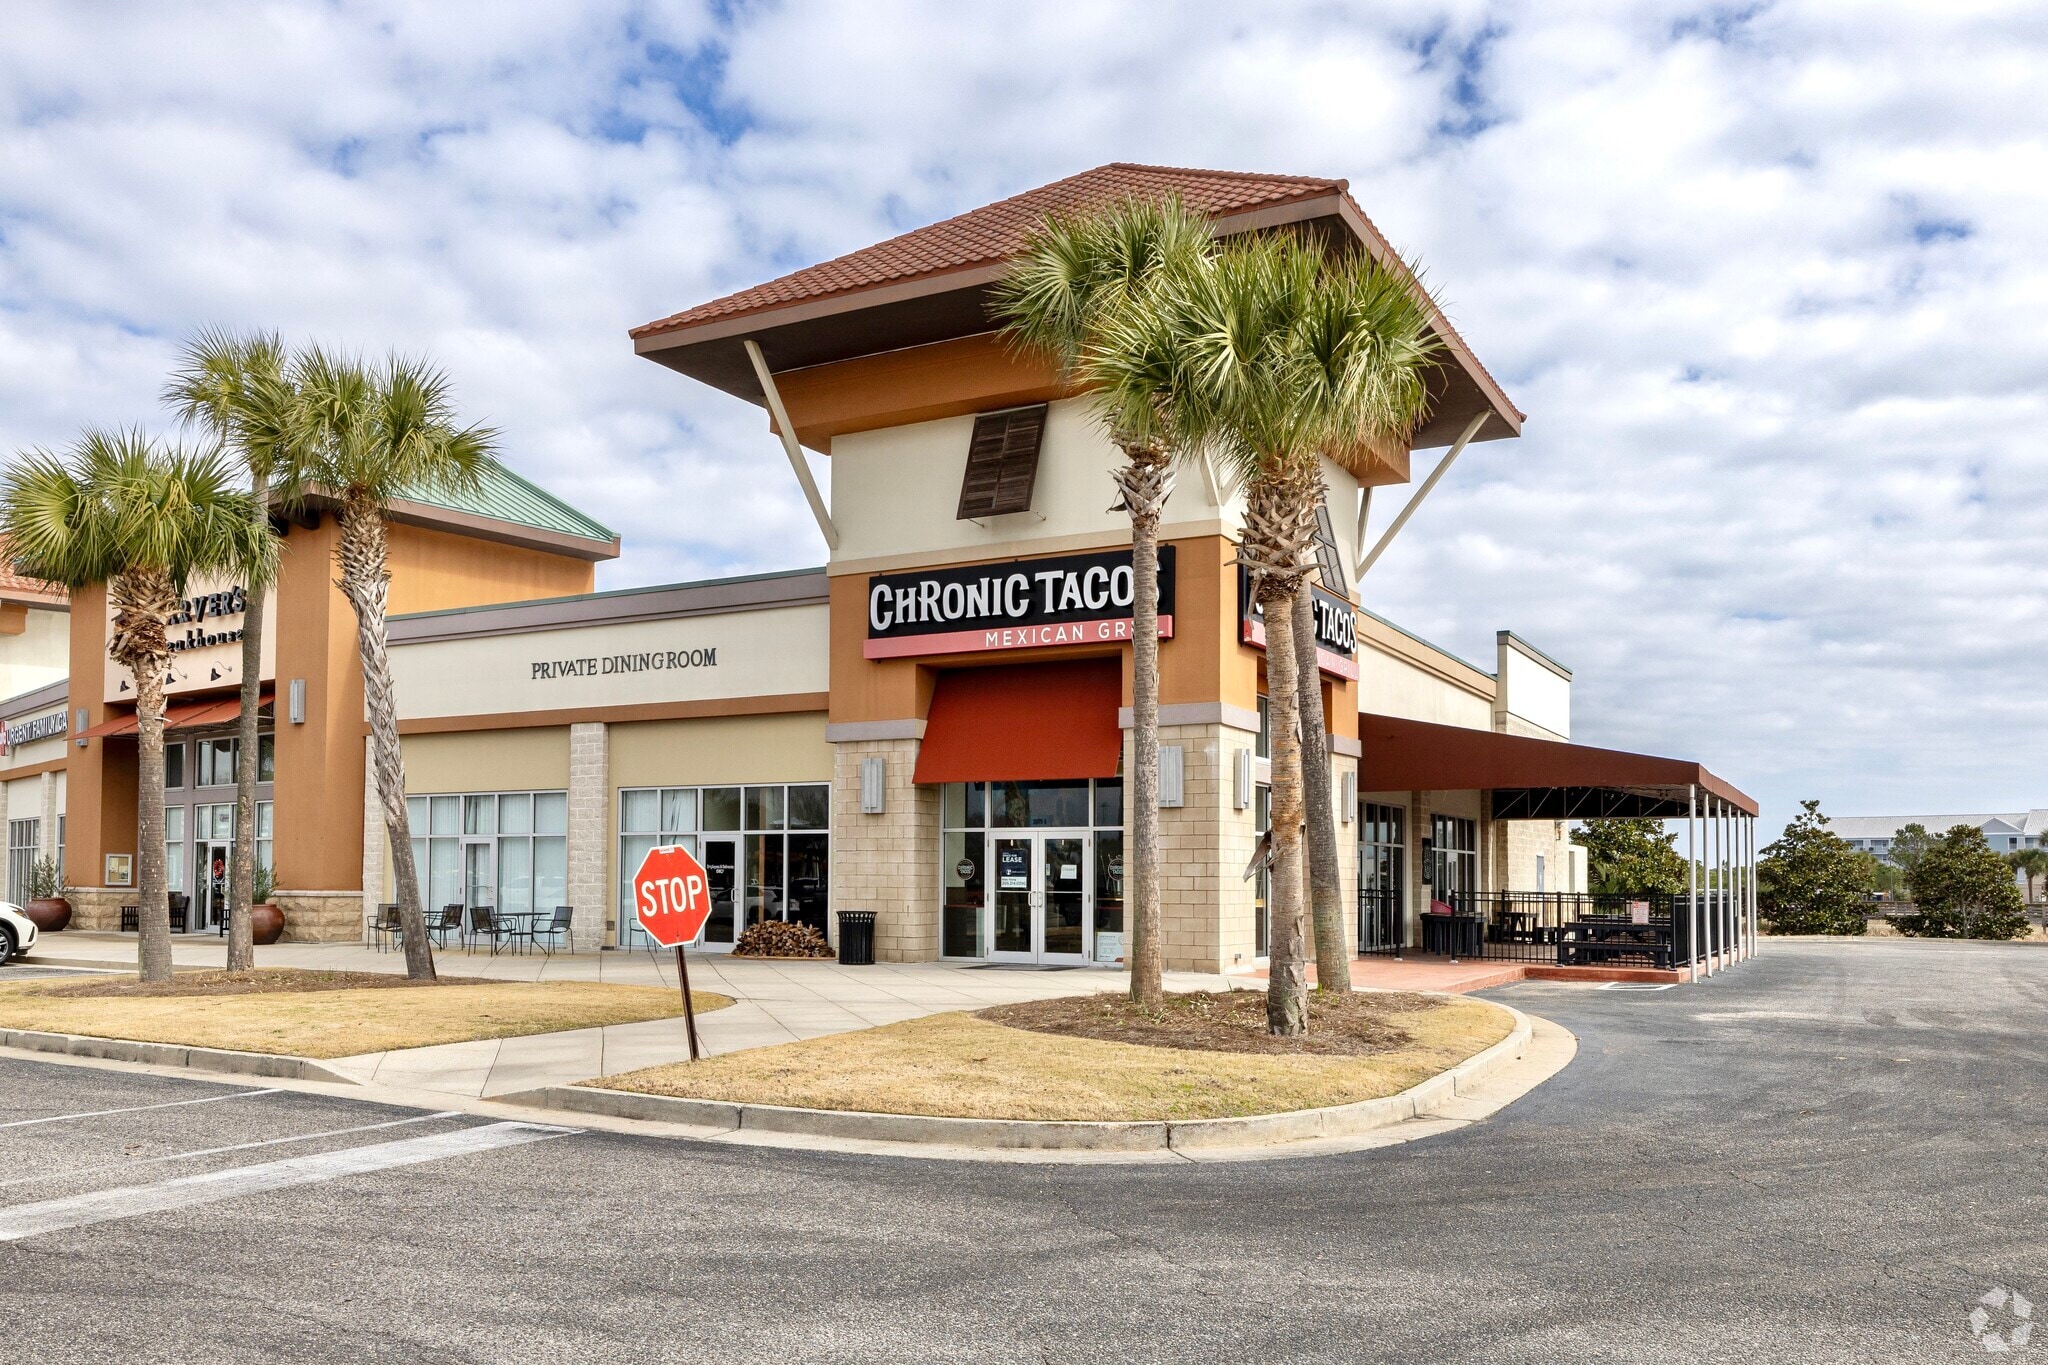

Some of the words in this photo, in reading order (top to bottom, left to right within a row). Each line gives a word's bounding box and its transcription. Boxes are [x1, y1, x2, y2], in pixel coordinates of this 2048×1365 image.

[167, 586, 248, 626] RVER'S
[869, 573, 1030, 631] CHRONIC
[1034, 563, 1160, 614] TACO
[167, 627, 244, 652] eakhouse
[985, 624, 1084, 648] MEXICAN
[1319, 599, 1358, 654] TACOS
[531, 657, 598, 680] PRIVATE
[601, 652, 664, 675] DINING
[666, 647, 717, 670] ROOM
[6, 722, 32, 746] URGENT
[32, 714, 58, 739] FAMILY
[57, 711, 68, 733] CA
[641, 875, 702, 917] STOP
